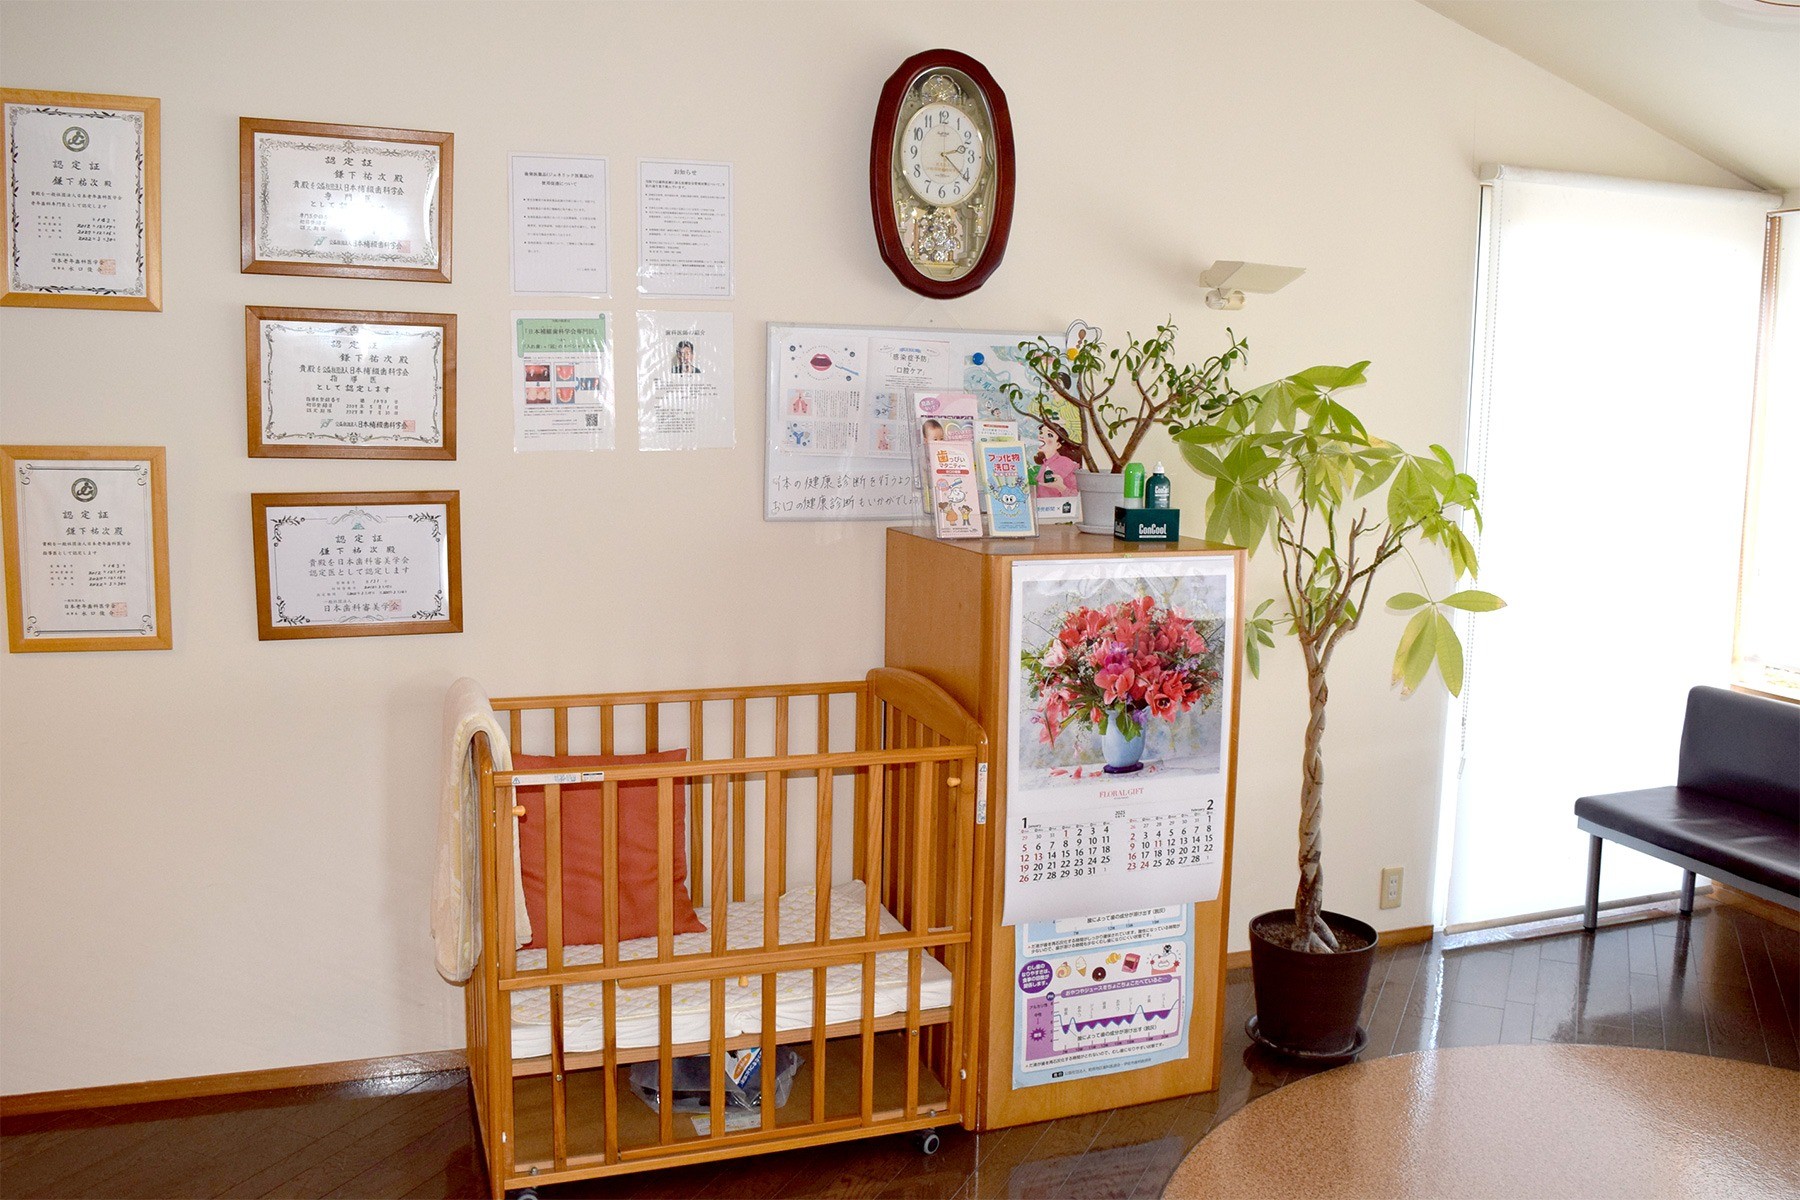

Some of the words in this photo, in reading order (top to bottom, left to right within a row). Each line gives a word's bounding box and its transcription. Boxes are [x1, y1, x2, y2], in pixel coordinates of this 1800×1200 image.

[925, 115, 932, 128] 11
[939, 111, 949, 124] 12
[957, 118, 960, 130] 1
[914, 128, 923, 141] 10
[964, 131, 972, 144] 2
[911, 145, 918, 159] 9
[968, 150, 974, 164] 3
[53, 160, 100, 171] 認定証
[325, 156, 373, 168] 認定証
[914, 164, 920, 178] 8
[963, 167, 970, 181] 4
[924, 180, 931, 193] 7
[939, 186, 945, 198] 6
[954, 182, 960, 195] 5
[62, 510, 109, 520] 認定証
[1139, 524, 1167, 534] ConCool
[335, 534, 383, 544] 認定証
[1100, 790, 1127, 798] FLORAL
[1207, 800, 1214, 810] 2
[1022, 818, 1027, 828] 1
[1091, 827, 1095, 835] 3
[1022, 844, 1027, 852] 5
[1204, 844, 1213, 852] 22
[1033, 863, 1043, 871] 20
[1061, 860, 1070, 868] 22
[1033, 873, 1042, 881] 27
[1061, 870, 1070, 878] 29
[1088, 867, 1095, 875] 31
